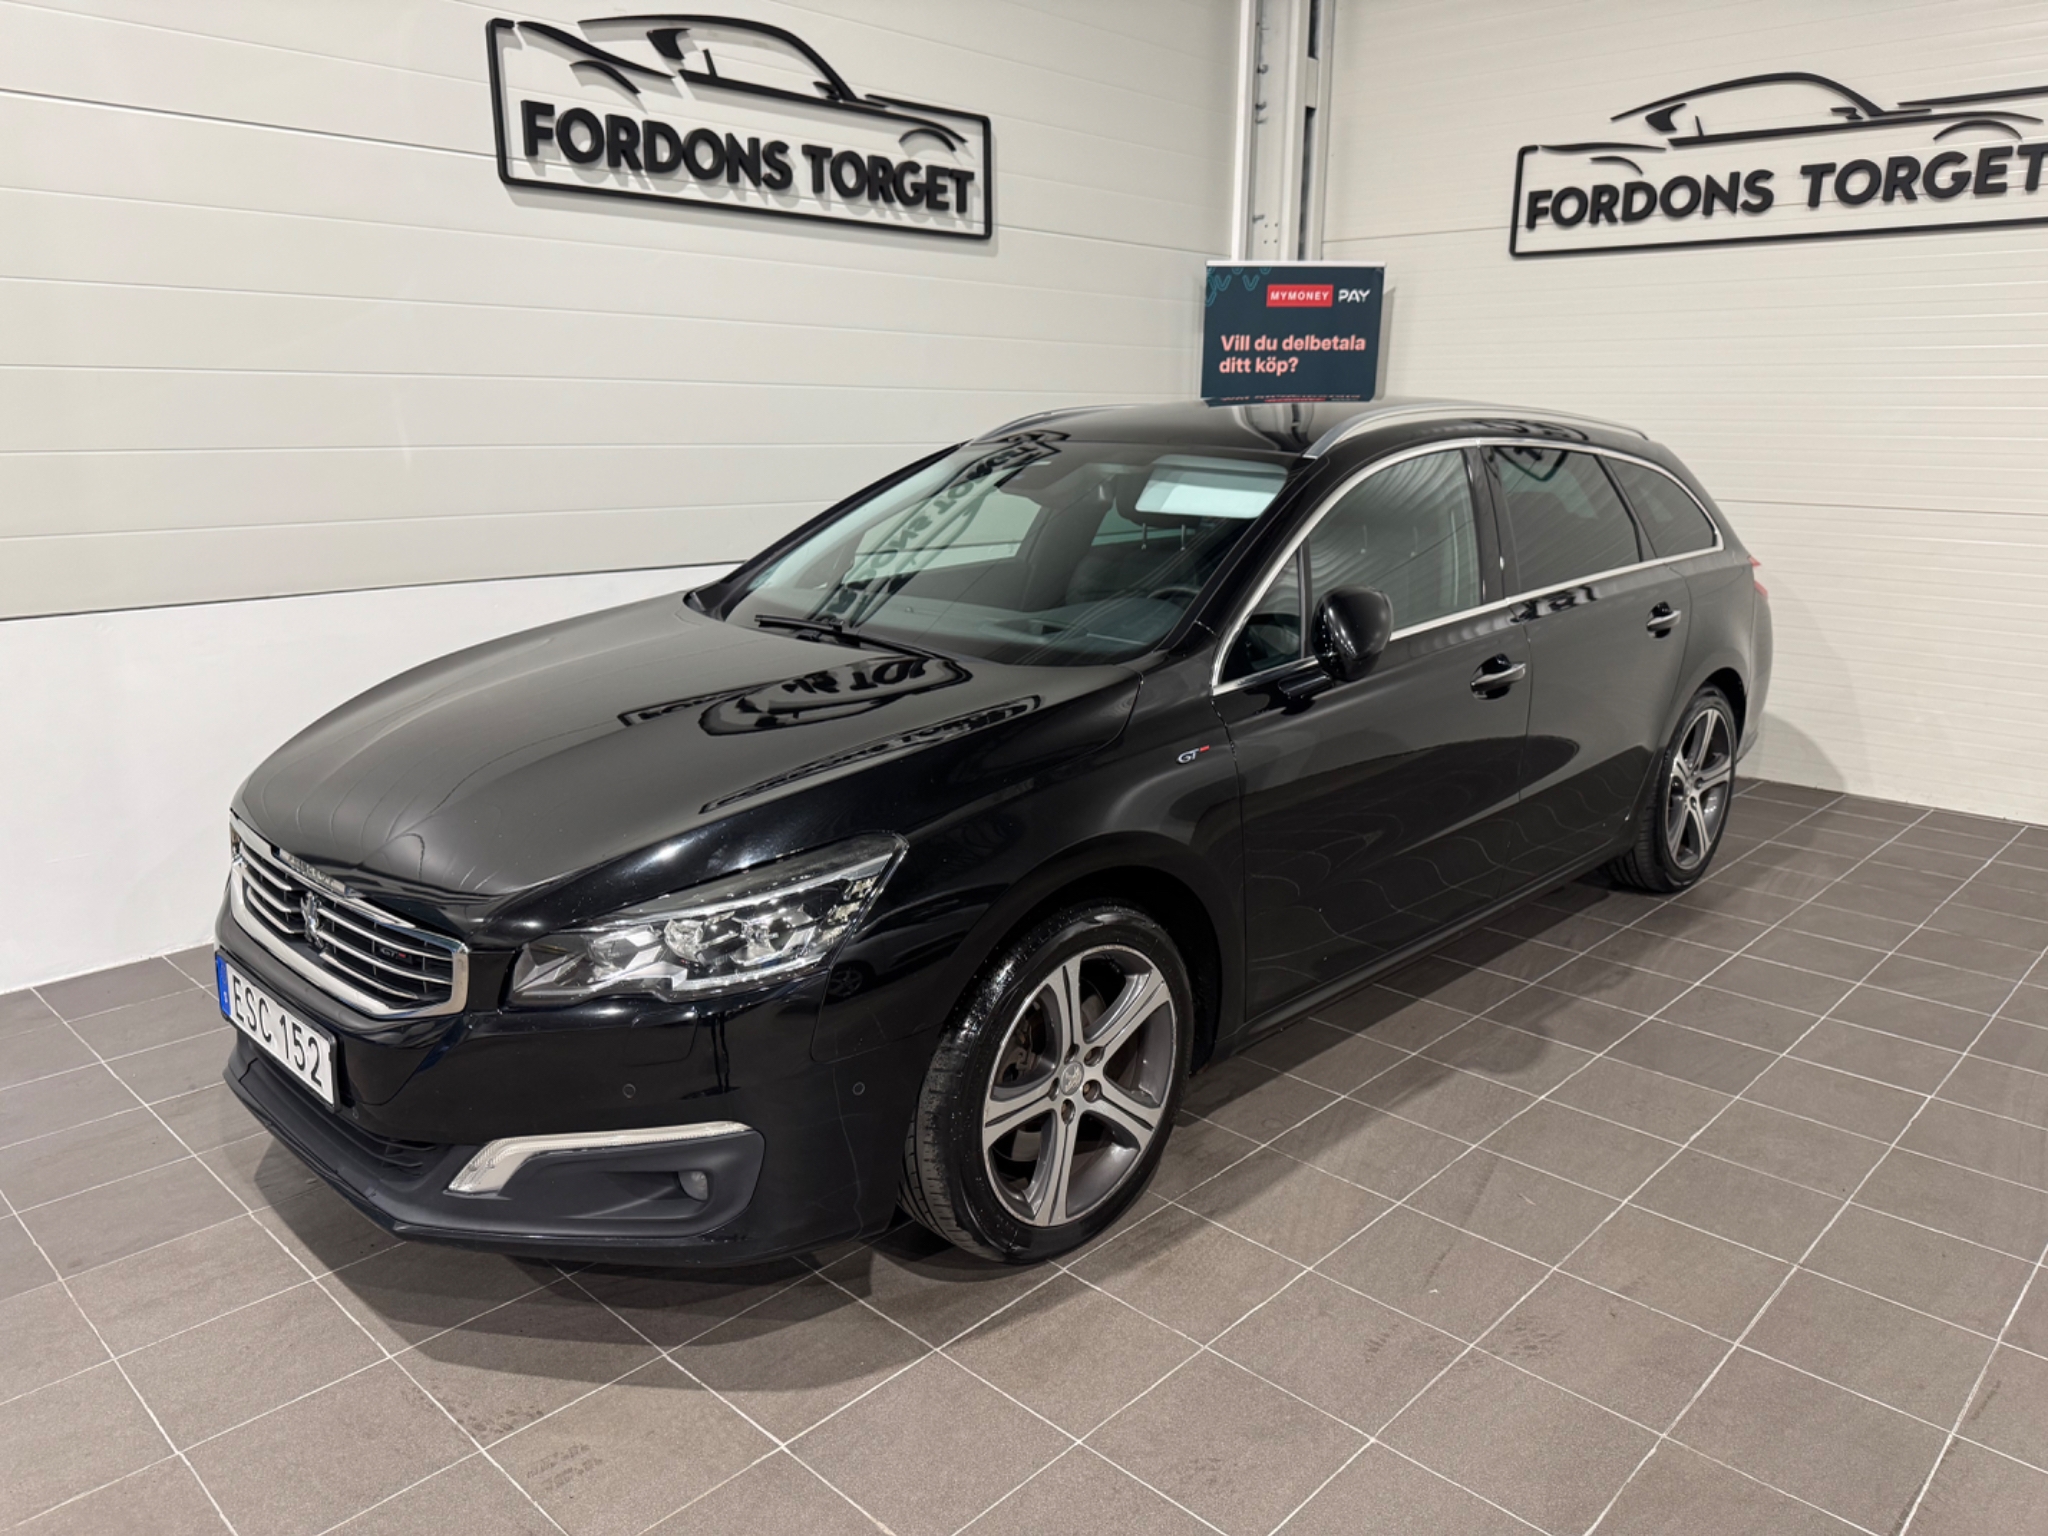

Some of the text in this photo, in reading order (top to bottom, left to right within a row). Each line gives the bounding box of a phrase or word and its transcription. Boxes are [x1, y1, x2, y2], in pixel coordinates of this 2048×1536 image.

[521, 100, 975, 213] FORDONS TORGET
[1526, 142, 2048, 230] FORDONS TORGET
[1270, 289, 1371, 303] MYMONEY PAY
[1221, 335, 1366, 351] Vill du delbetala
[1219, 356, 1299, 377] ditt köp?
[1178, 747, 1200, 764] GT
[232, 974, 323, 1088] ESC 152
